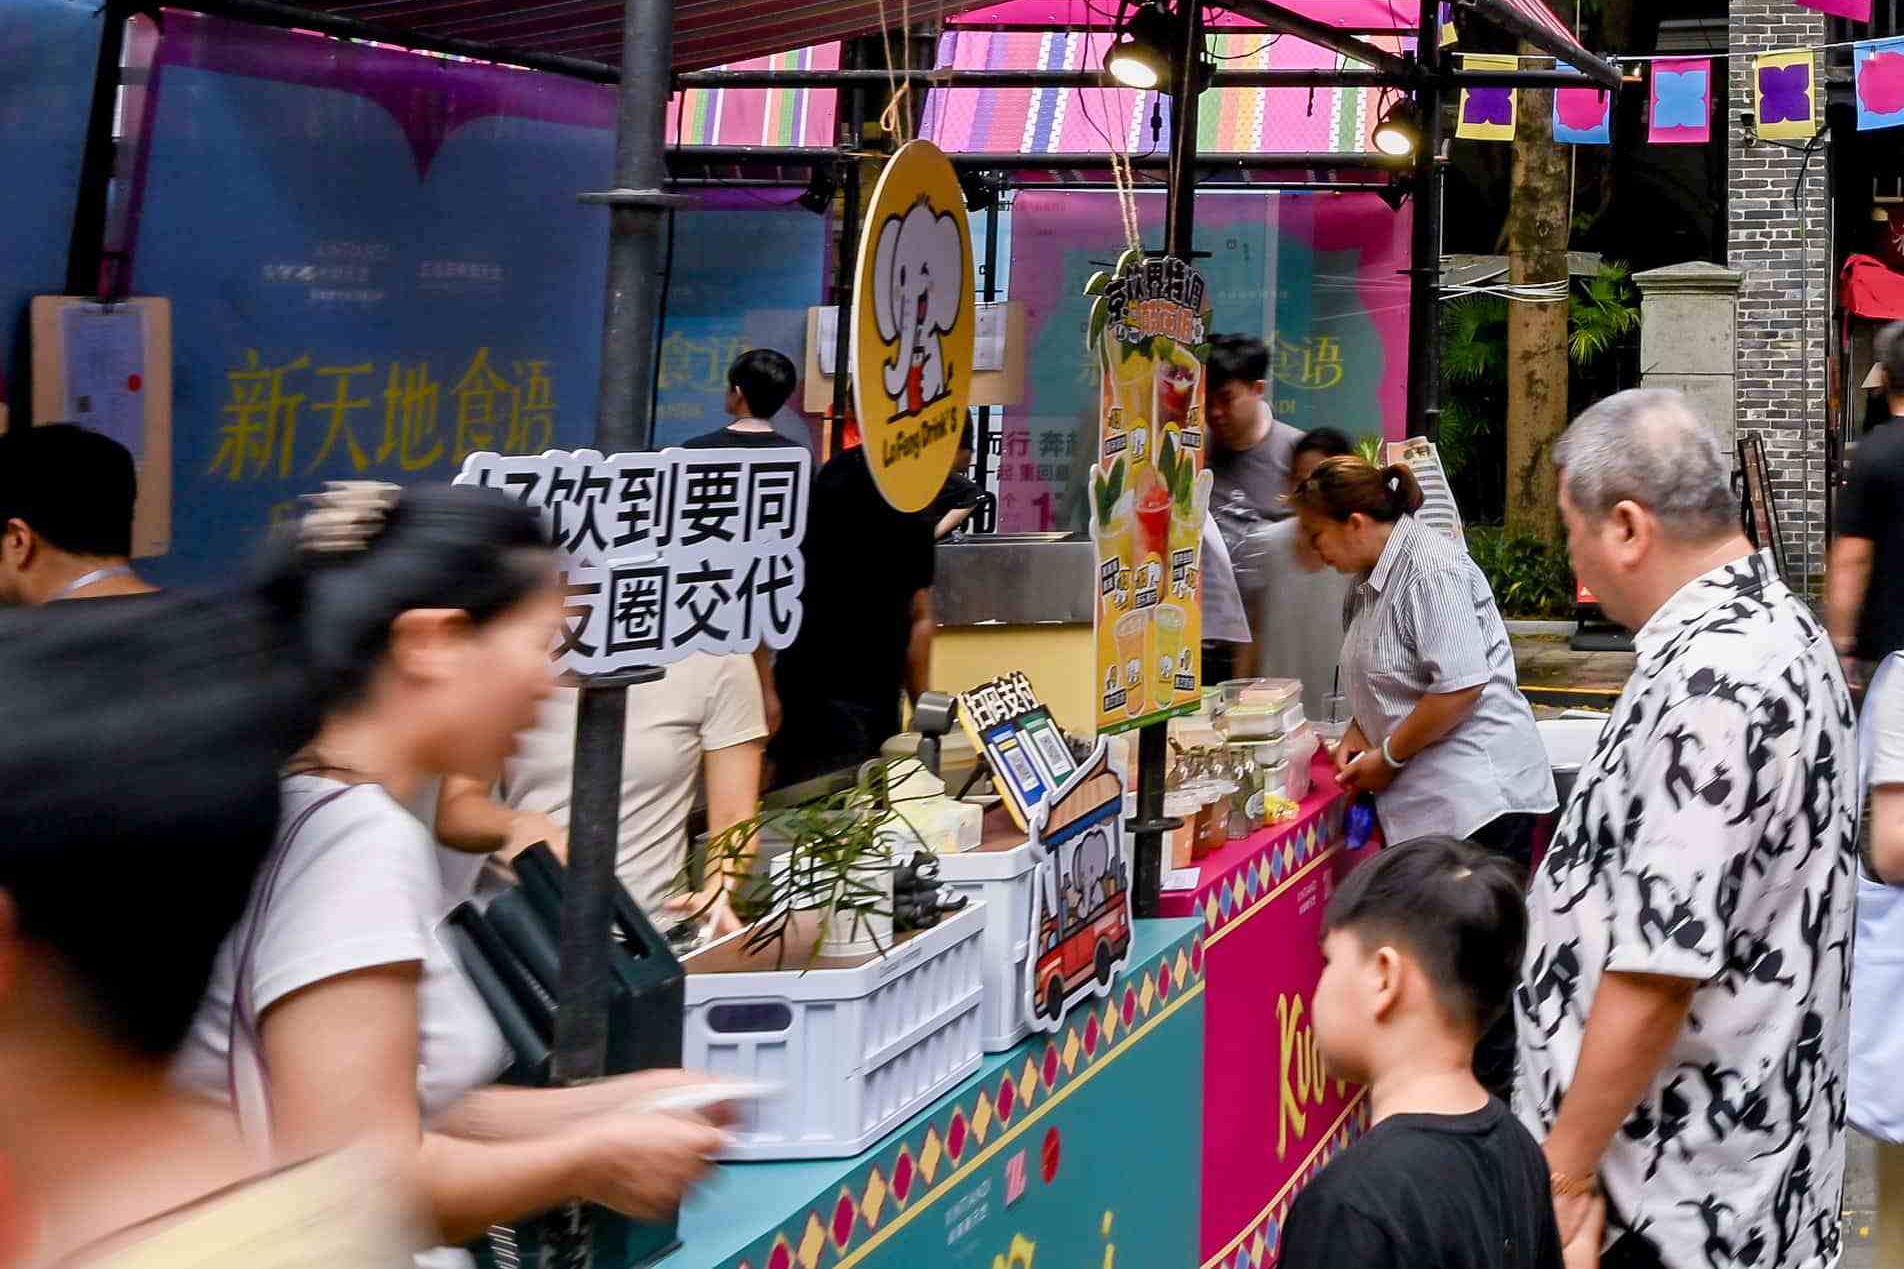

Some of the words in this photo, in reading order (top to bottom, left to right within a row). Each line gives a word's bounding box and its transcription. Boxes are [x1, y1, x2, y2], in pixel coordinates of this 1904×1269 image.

[208, 345, 557, 482] 新天地食语
[552, 555, 795, 662] 友圈交代
[960, 673, 1041, 730] 扫码支付
